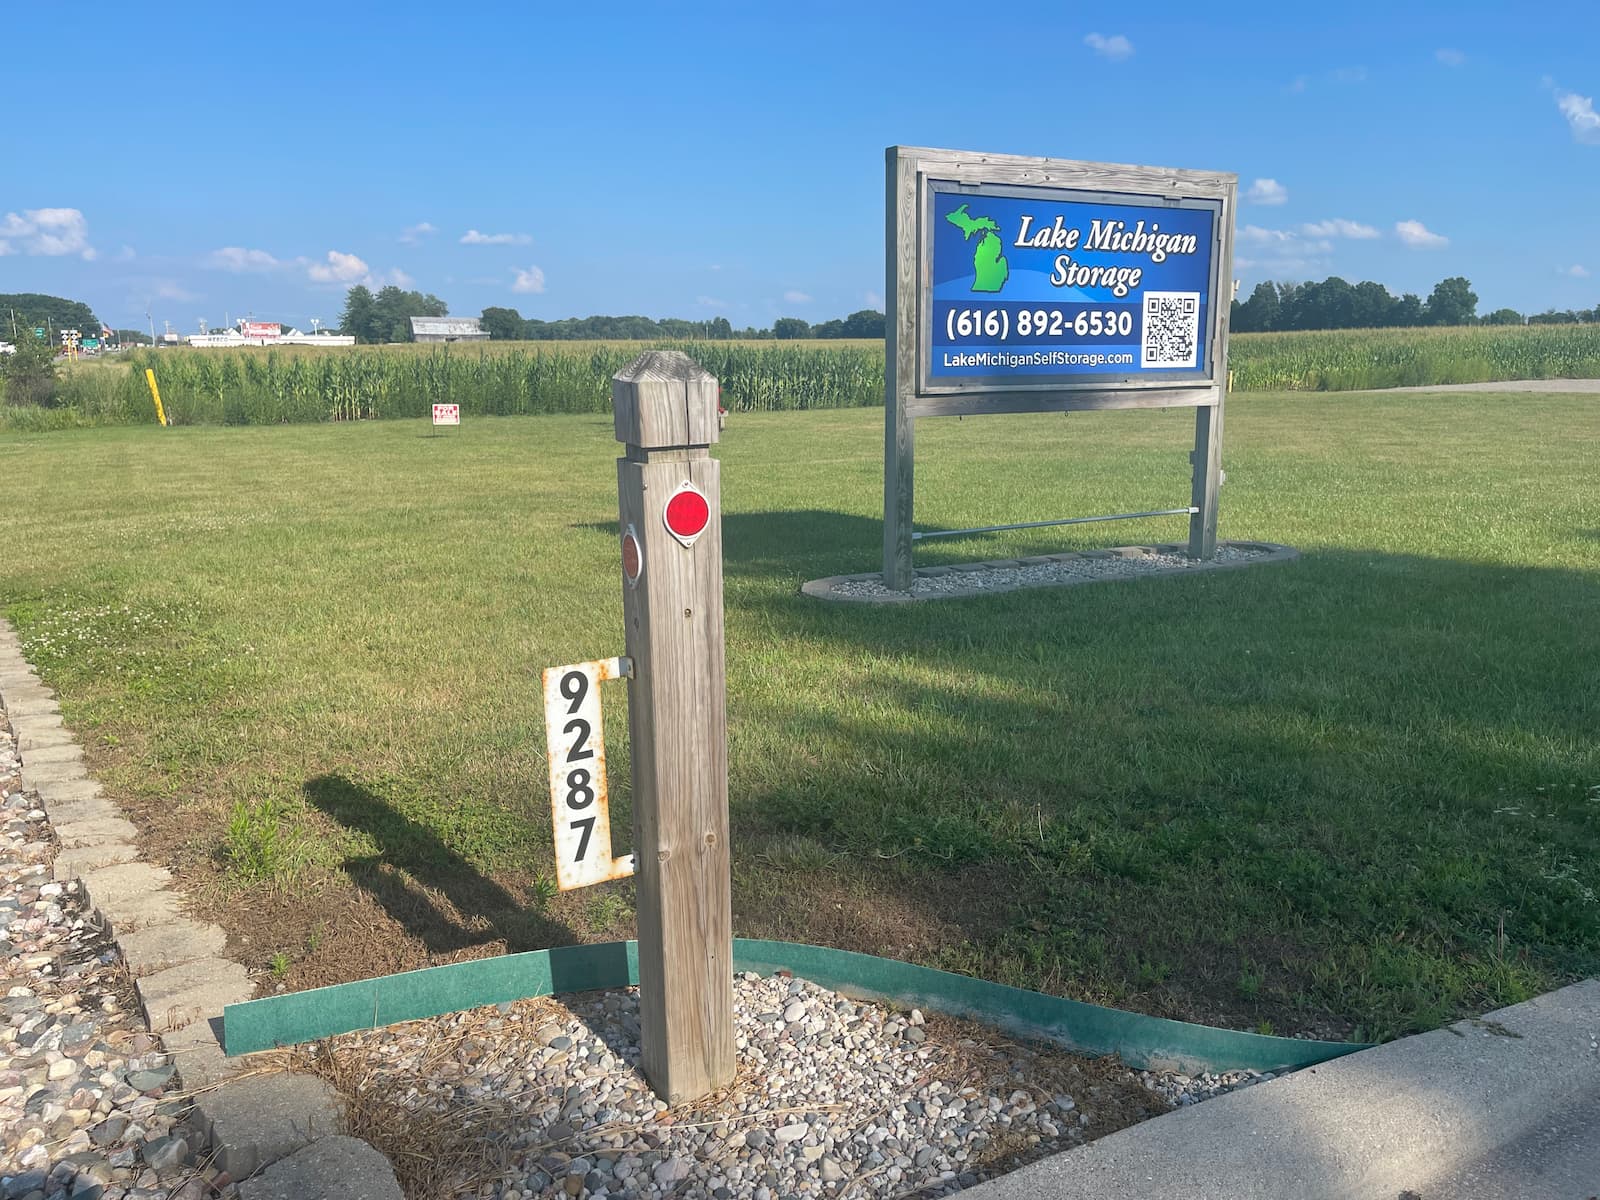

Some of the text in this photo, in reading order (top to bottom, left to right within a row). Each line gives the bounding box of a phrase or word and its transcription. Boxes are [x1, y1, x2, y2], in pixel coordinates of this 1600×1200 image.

[1014, 215, 1197, 263] Lake Michigan
[1050, 254, 1142, 297] Storage
[946, 309, 1133, 340] (616) 892-6530
[943, 352, 1133, 368] LakeMichiganSelfStorage.com
[559, 670, 597, 863] 9287
